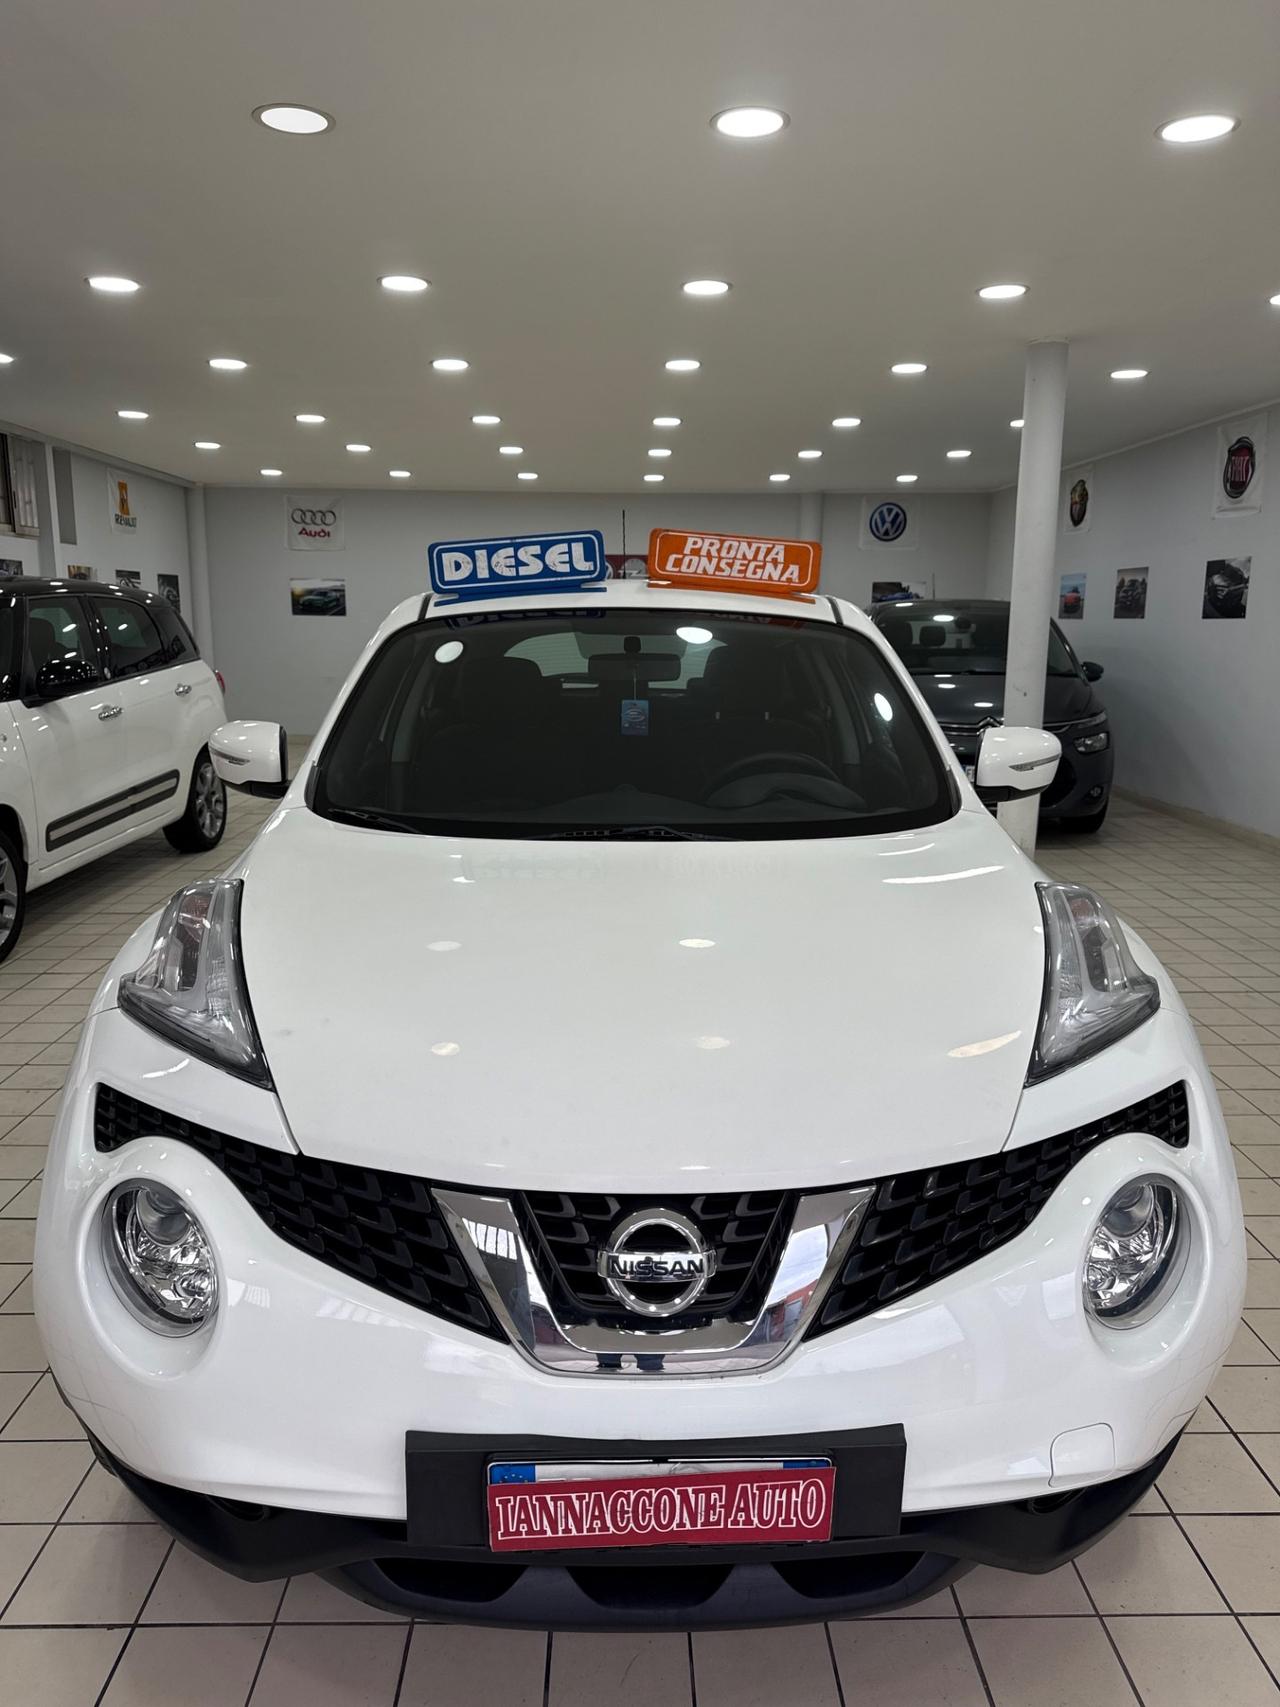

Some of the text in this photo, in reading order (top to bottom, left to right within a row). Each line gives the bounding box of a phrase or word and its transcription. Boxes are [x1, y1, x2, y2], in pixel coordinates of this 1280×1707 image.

[441, 542, 594, 581] DIESEL
[683, 537, 786, 563] PRONTA
[665, 554, 800, 583] CONSEGNA
[608, 1258, 704, 1276] NISSAN
[495, 1478, 827, 1540] IANNACCONE AUTO
